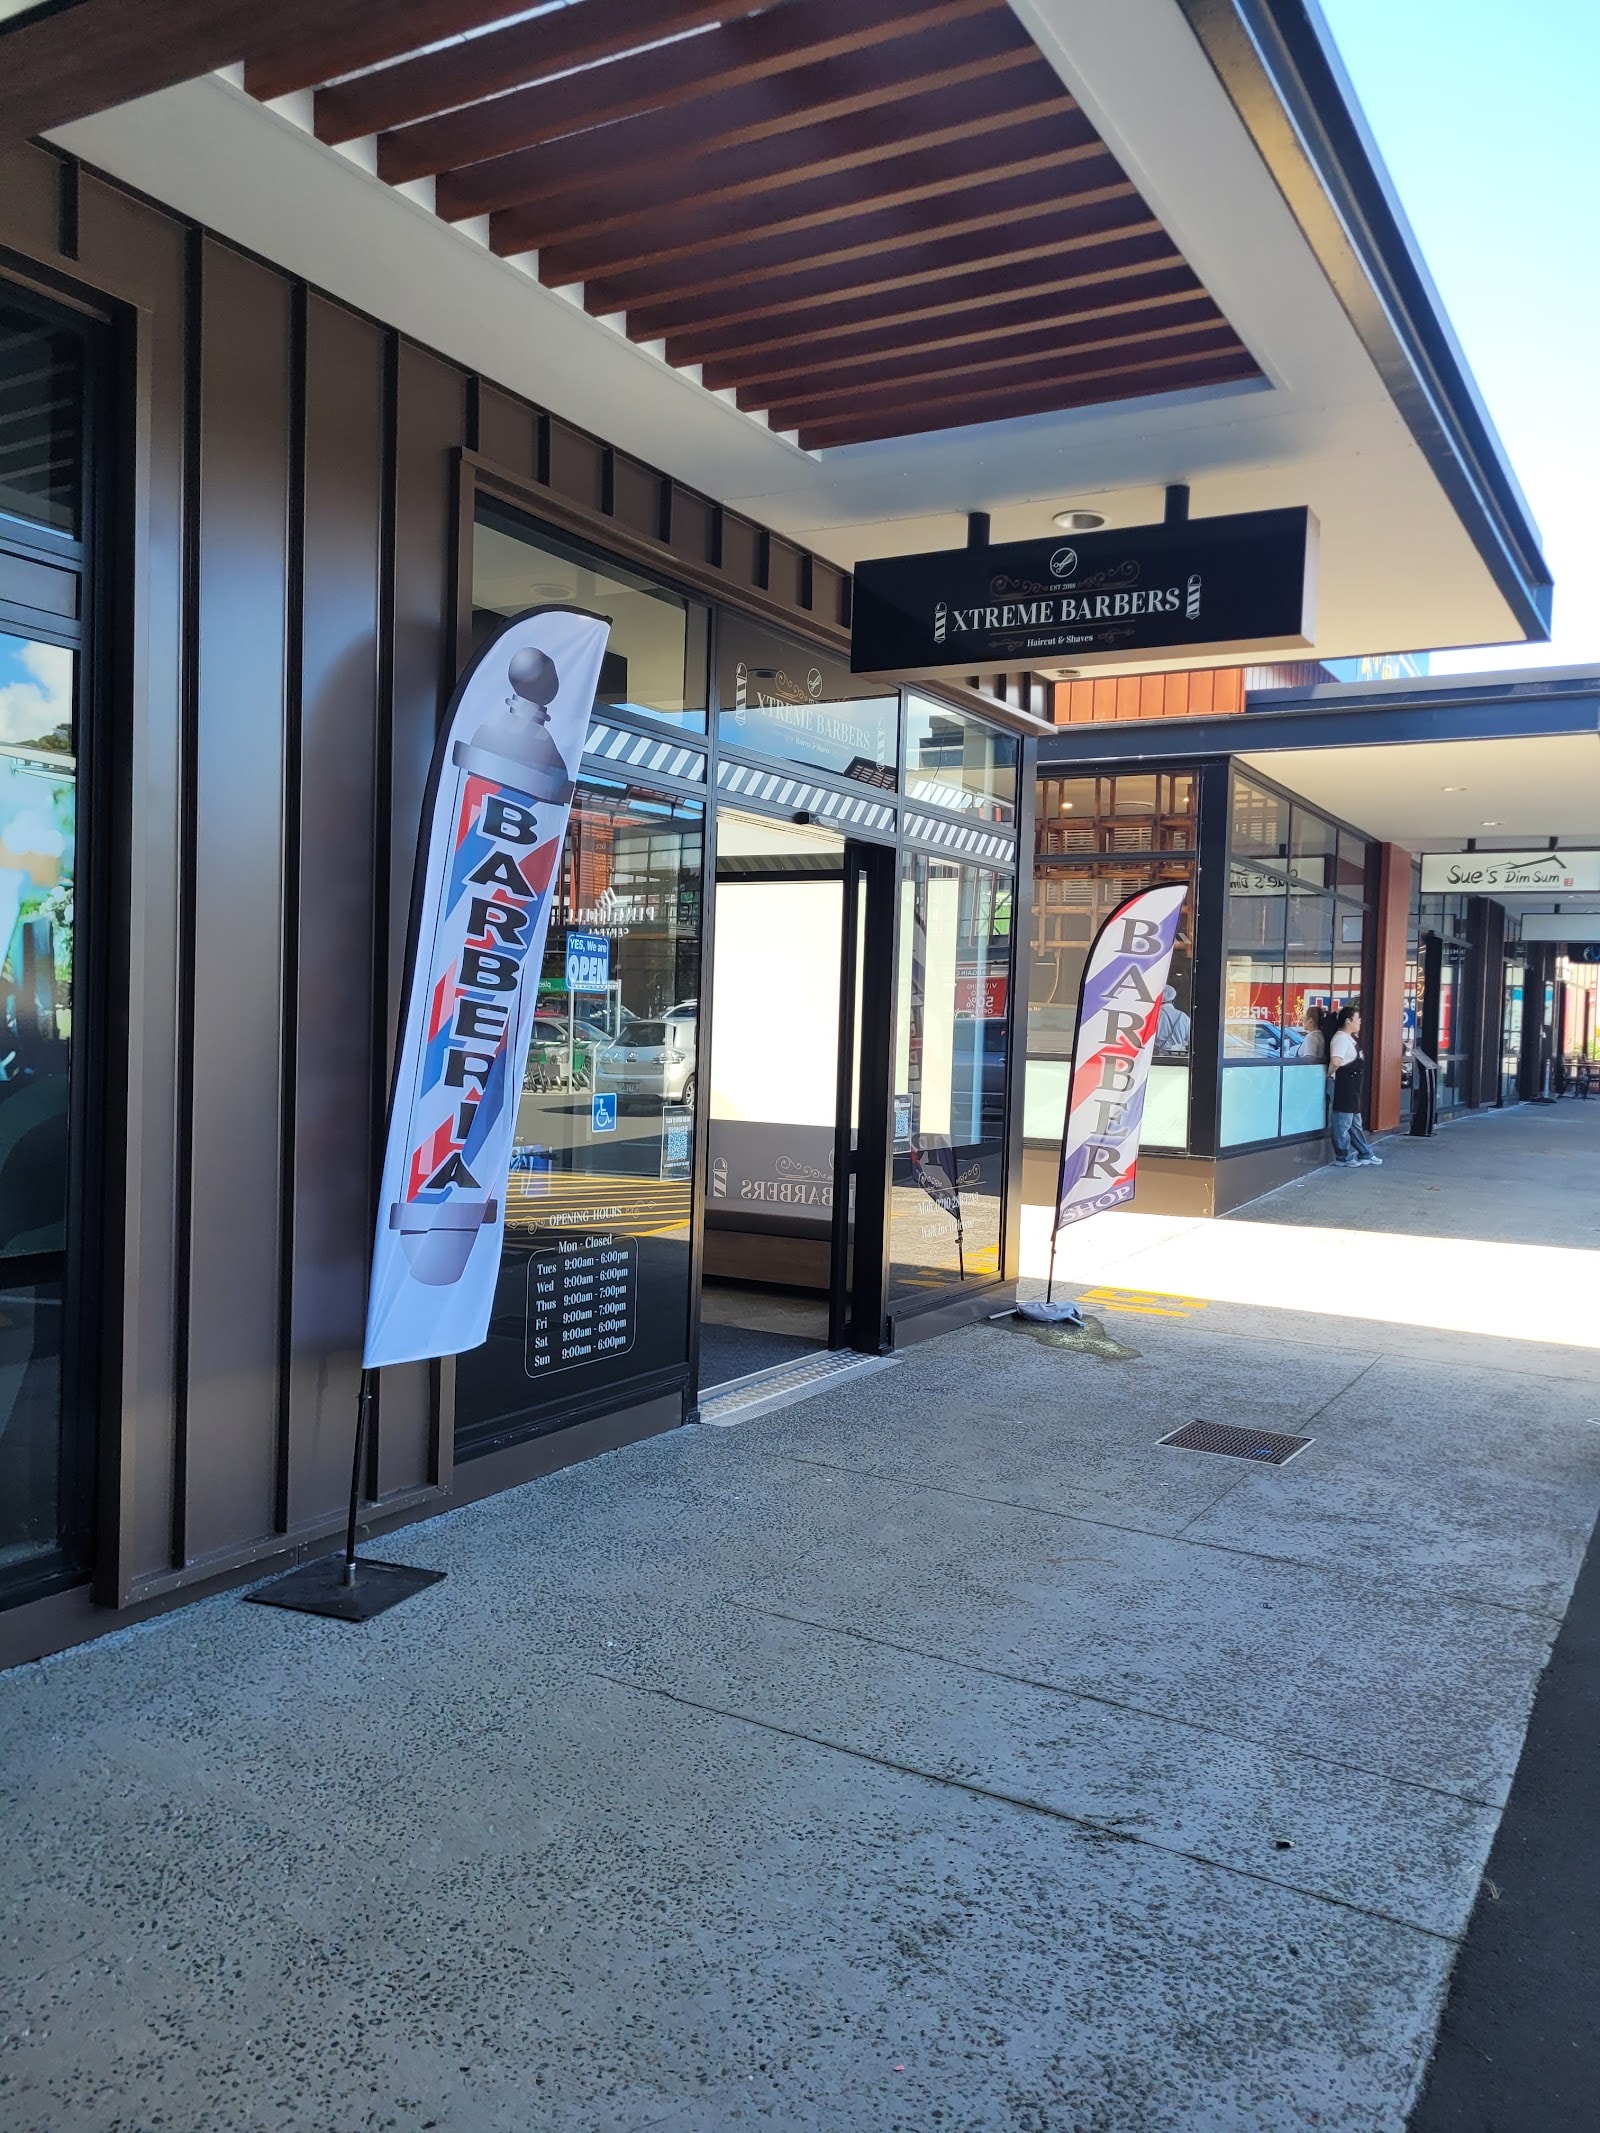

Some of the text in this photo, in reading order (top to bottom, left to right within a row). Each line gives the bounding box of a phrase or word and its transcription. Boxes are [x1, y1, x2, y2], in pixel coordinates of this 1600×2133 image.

[1050, 584, 1061, 592] EST
[951, 587, 1180, 632] XTREME BARBERS
[1027, 634, 1094, 648] Haircut & Shaves
[756, 692, 871, 751] XTREME BARBERS
[1447, 864, 1498, 885] Sue's
[1505, 870, 1530, 883] Dim
[1533, 870, 1560, 883] Sum
[570, 938, 607, 953] YES, We are
[568, 955, 608, 985] OPEN
[427, 796, 541, 1192] BARBERIA
[1081, 917, 1163, 1181] BARBER
[549, 1205, 622, 1227] OPENING HOURS
[1062, 1185, 1130, 1223] SHOP
[558, 1240, 578, 1254] Mon
[585, 1233, 612, 1249] Closed
[537, 1263, 557, 1276] Tues
[564, 1257, 594, 1271] 9:00am
[600, 1250, 629, 1265] 6:00pm
[537, 1280, 554, 1294] Wed
[563, 1275, 593, 1288] 9:00am
[600, 1267, 629, 1282] 6:00pm
[536, 1298, 557, 1312] Thus
[563, 1293, 593, 1306] 9:00am
[599, 1284, 627, 1299] 7:00pm
[535, 1317, 548, 1331] Fri
[562, 1310, 592, 1324] 9:00am
[598, 1301, 627, 1316] 7:00pm
[535, 1336, 548, 1349] Sat
[562, 1328, 592, 1342] 9:00am
[598, 1318, 627, 1333] 6:00pm
[534, 1354, 551, 1367] Sun
[561, 1344, 592, 1359] 9:00am
[597, 1335, 627, 1350] 6:00pm
